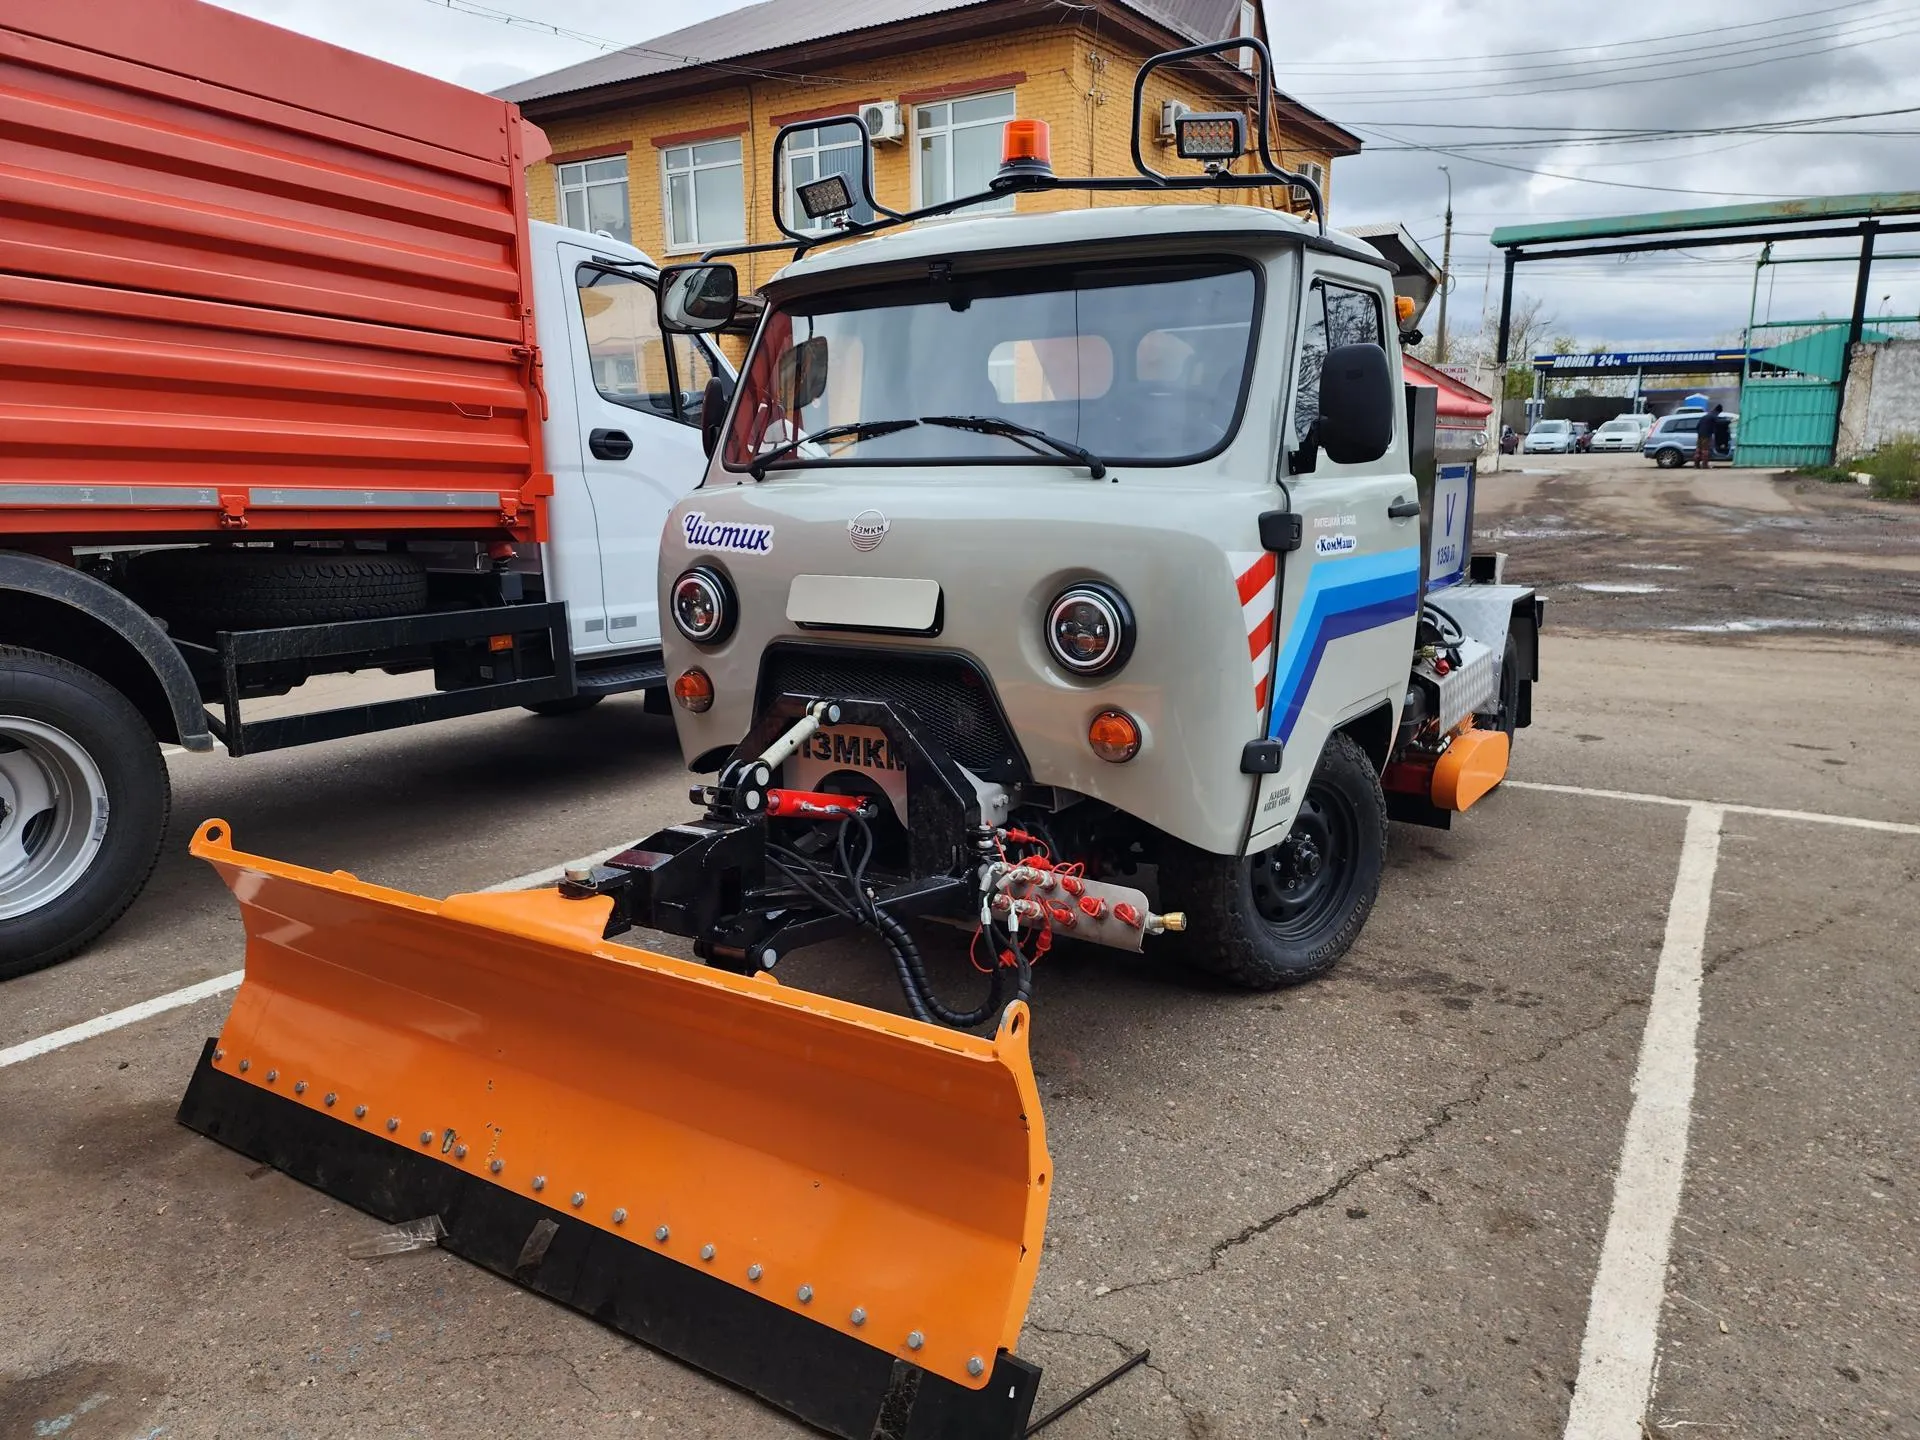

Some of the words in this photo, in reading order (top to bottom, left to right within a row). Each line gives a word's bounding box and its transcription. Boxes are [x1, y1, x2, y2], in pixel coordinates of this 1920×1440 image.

[684, 514, 770, 551] Чистик
[851, 524, 884, 535] ЛЗМКМ
[1446, 492, 1457, 537] V
